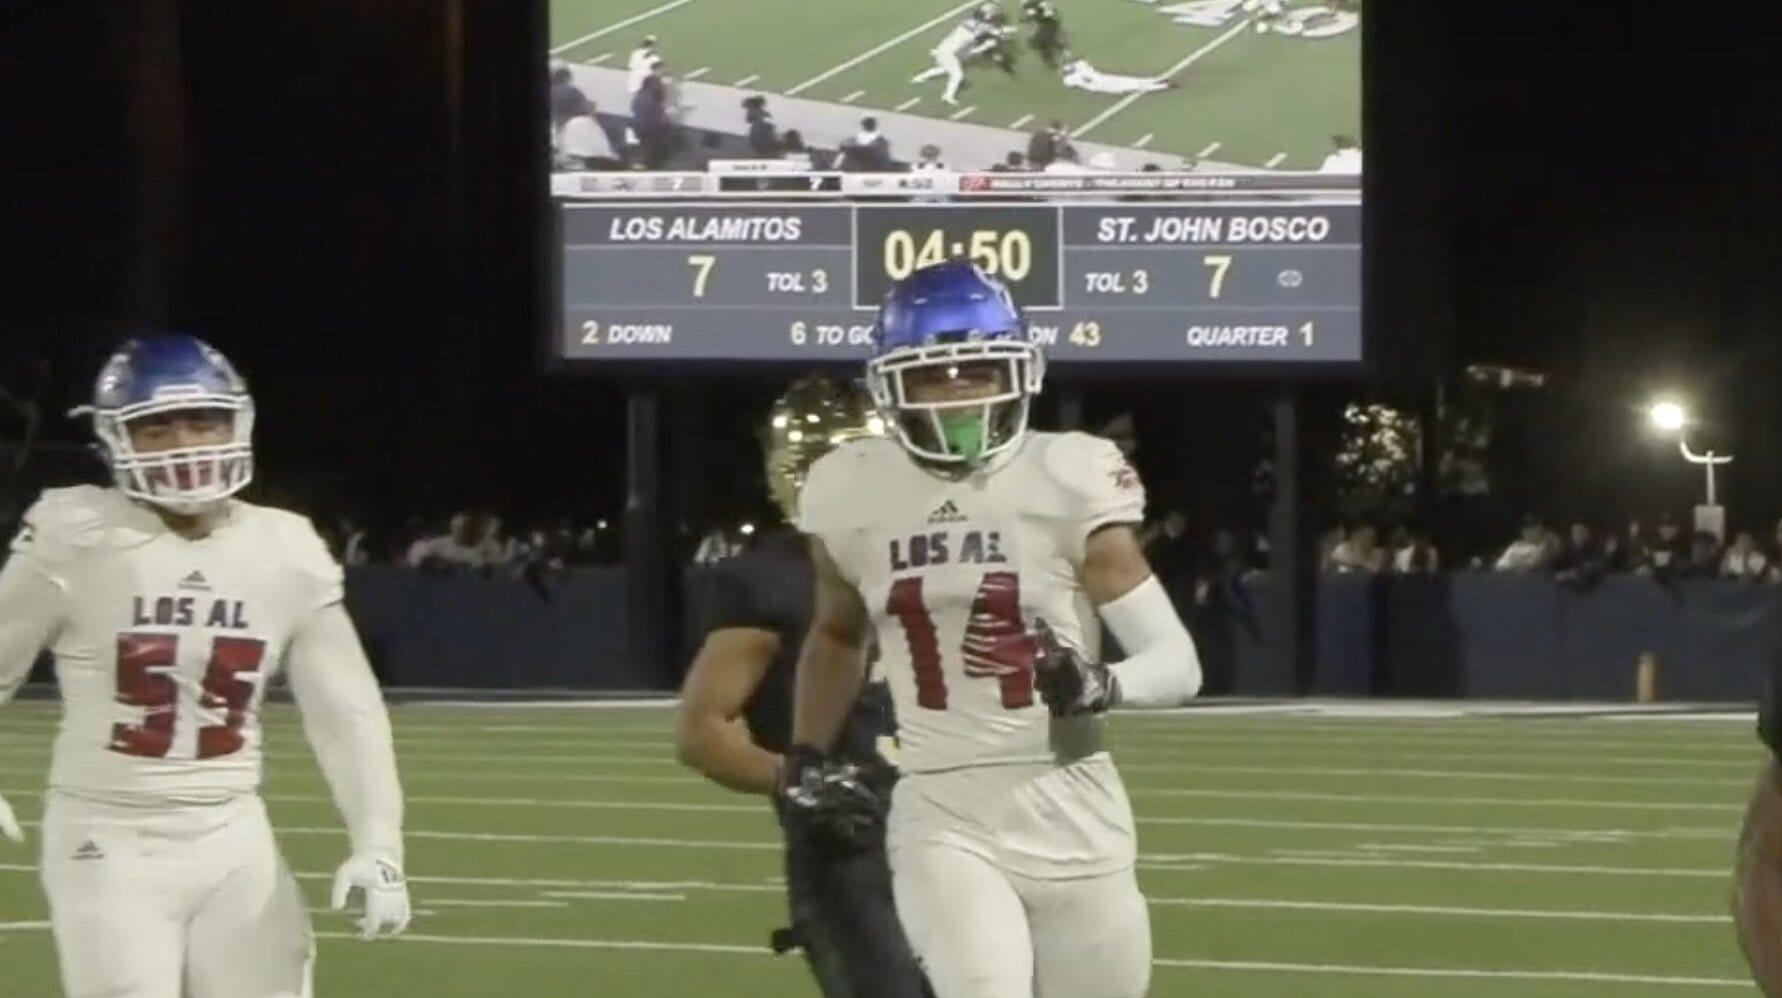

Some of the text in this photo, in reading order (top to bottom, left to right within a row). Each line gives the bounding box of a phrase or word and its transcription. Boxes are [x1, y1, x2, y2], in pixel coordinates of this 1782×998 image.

[609, 217, 802, 241] LOS ALAMITOS
[1097, 217, 1330, 242] ST. JOHN BOSCO
[884, 229, 1031, 281] 04:50
[688, 255, 716, 298] 7
[766, 269, 829, 294] TOL 3
[1085, 269, 1149, 294] TOL 3
[1203, 255, 1232, 298] 7
[581, 320, 672, 345] 2 DOWN
[790, 321, 807, 345] 6
[816, 326, 844, 344] TO
[1069, 321, 1101, 347] 43
[1187, 321, 1314, 347] QUARTER 1
[889, 532, 948, 571] LOS
[133, 596, 250, 629] LOS AL
[887, 571, 1034, 711] 14
[107, 632, 268, 760] 55
